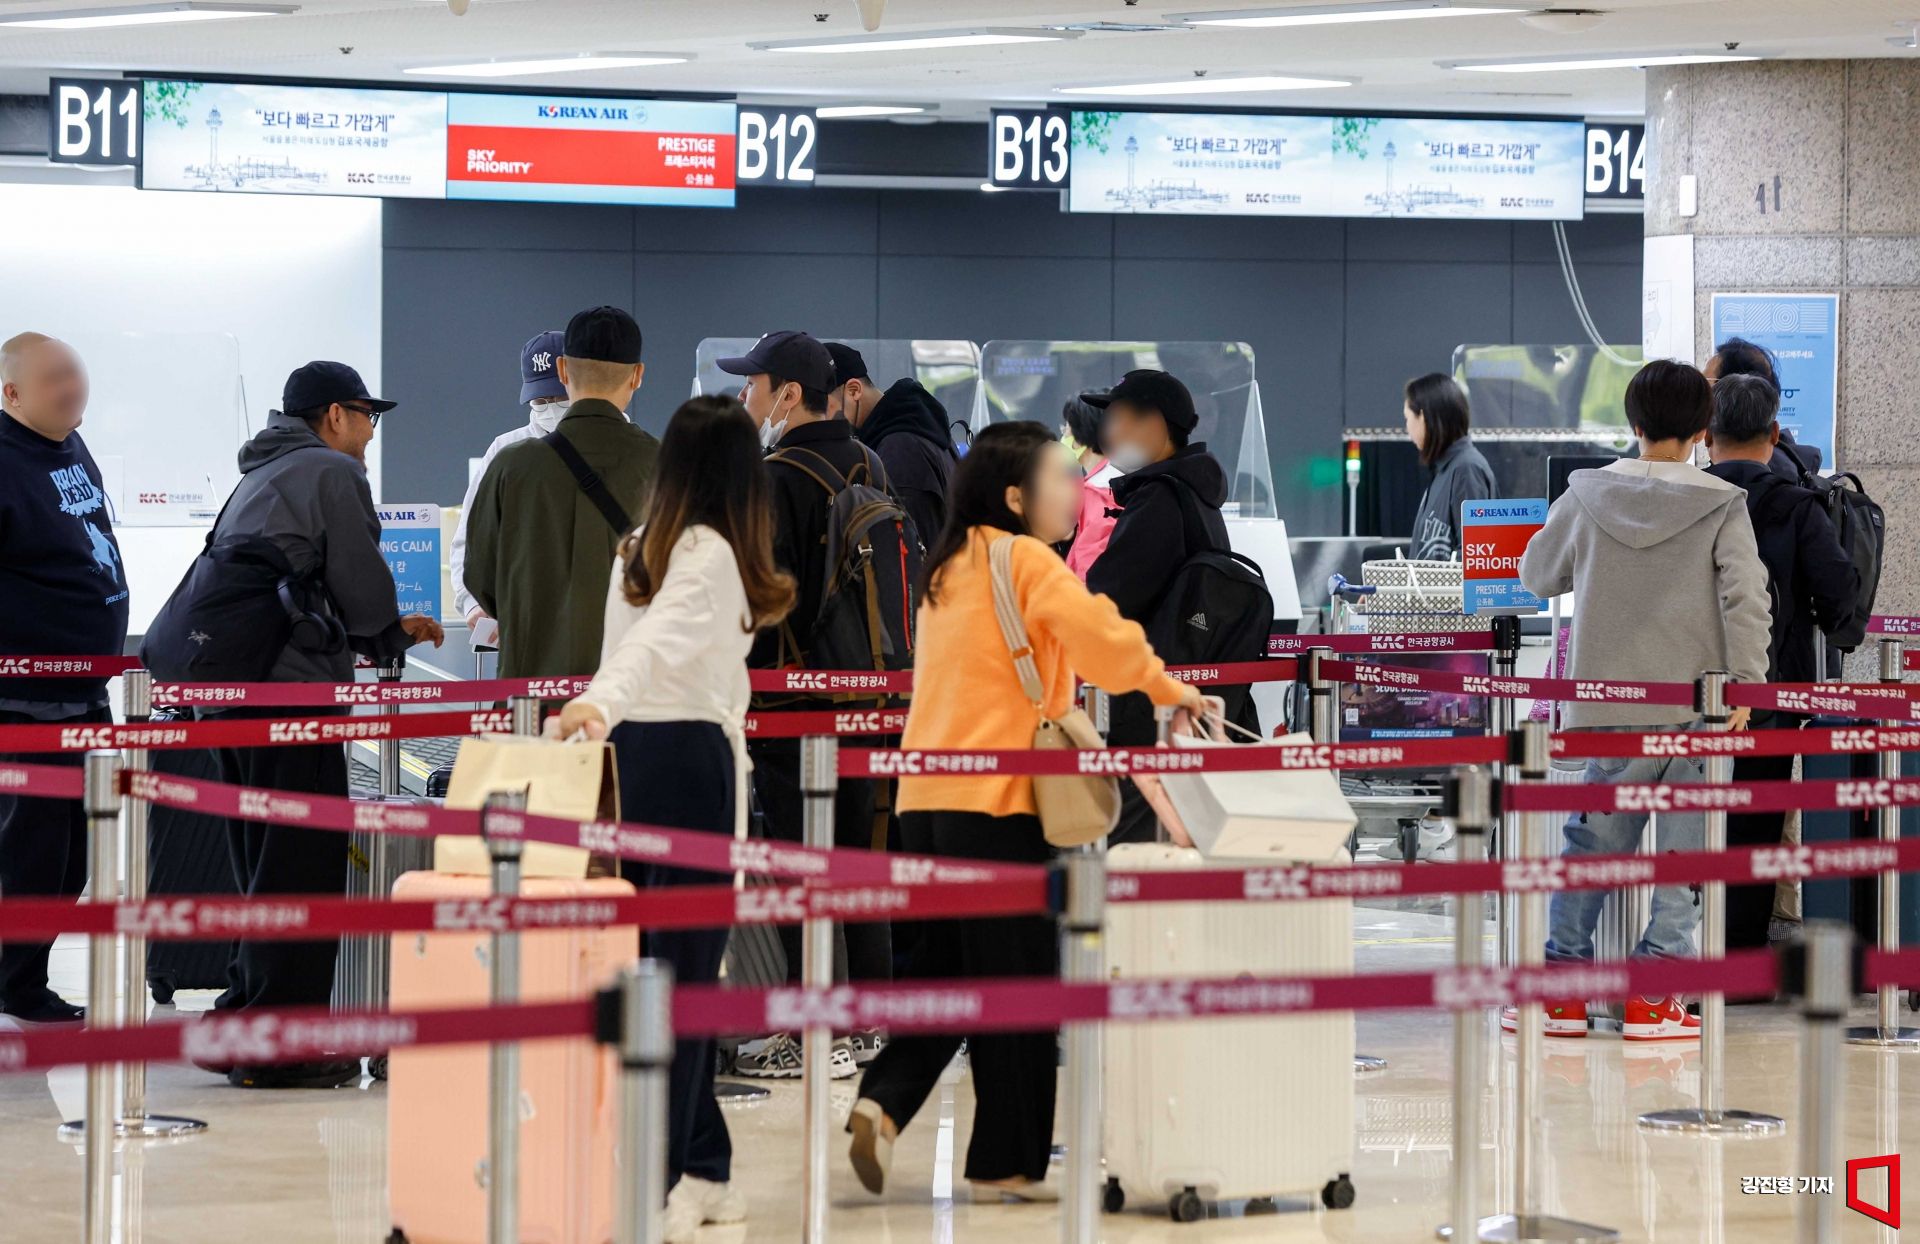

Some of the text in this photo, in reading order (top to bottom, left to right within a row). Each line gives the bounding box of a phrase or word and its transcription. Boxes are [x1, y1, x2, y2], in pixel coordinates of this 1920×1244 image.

[59, 86, 136, 157] B11
[296, 112, 340, 129] 빠르고
[538, 105, 628, 120] KOREAN AIR
[658, 136, 716, 153] PRESTIGE
[738, 112, 815, 181] B12
[995, 115, 1069, 183] B13
[1201, 137, 1239, 154] 빠르고
[1458, 142, 1494, 159] 빠르고
[467, 149, 495, 161] SKY
[1586, 129, 1645, 193] B14
[467, 161, 531, 174] PRIORITY
[348, 173, 375, 184] KAC
[139, 493, 167, 504] KAC
[394, 511, 416, 520] AIR
[1470, 507, 1529, 518] KOREAN AIR
[401, 540, 433, 553] CALM
[1466, 543, 1496, 556] SKY
[1475, 585, 1507, 594] PRESTIGE
[1884, 618, 1909, 632] KAC
[1371, 635, 1455, 650] KAC 한국공항공사
[34, 661, 92, 673] 한국공항공사
[1355, 665, 1419, 685] KAC 한국공항공사
[527, 679, 570, 697] KAC
[786, 673, 887, 689] KAC 한국공항공사
[1463, 675, 1490, 693] KAC
[151, 685, 246, 703] AC 한국공항공사
[334, 685, 442, 703] KAC 한국공항공사
[1576, 682, 1605, 699] KAC
[1776, 690, 1810, 710] KAC
[835, 712, 880, 732] KAC
[61, 728, 112, 748] KAC
[269, 721, 319, 742] KAC
[1831, 729, 1876, 750] KAC
[1642, 734, 1688, 756] KAC
[869, 751, 921, 774] KAC
[1078, 751, 1130, 773] KAC
[1281, 747, 1331, 767] KAC
[1615, 785, 1672, 810] KAC
[1836, 781, 1890, 806] KAC
